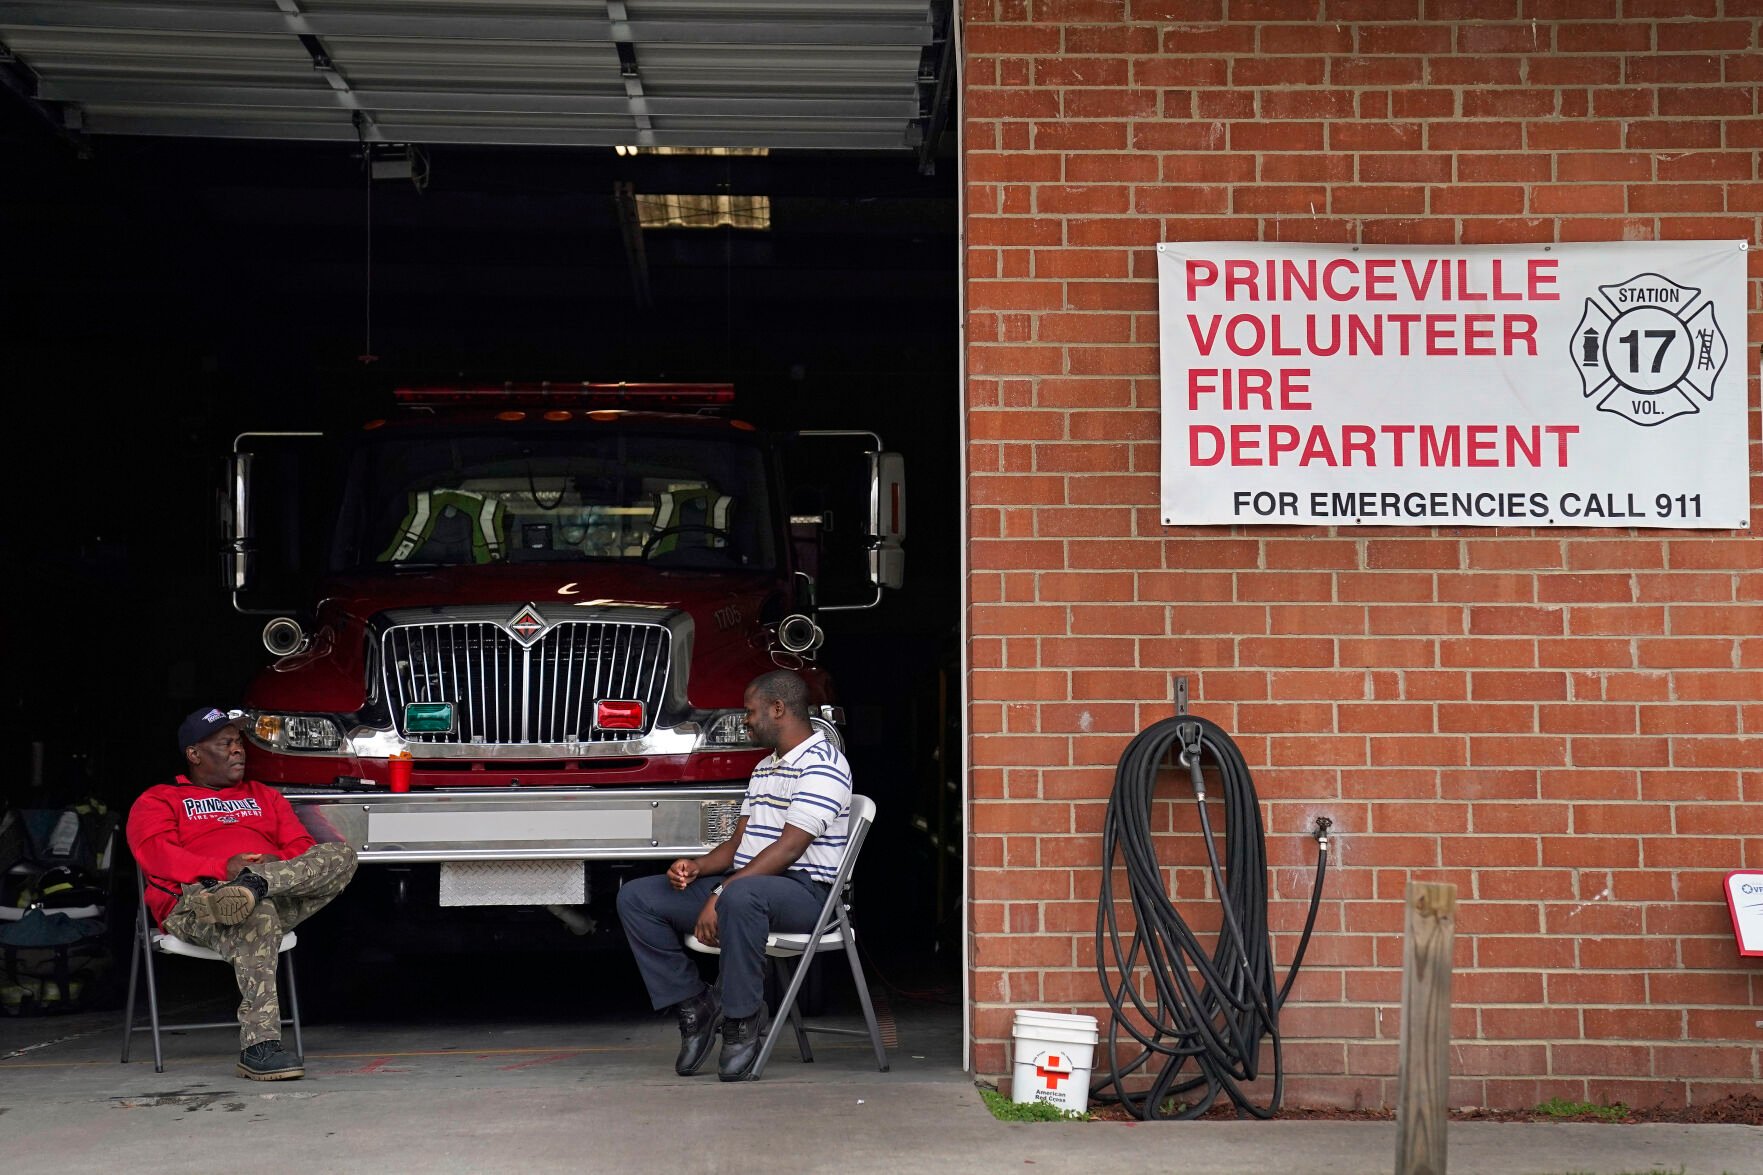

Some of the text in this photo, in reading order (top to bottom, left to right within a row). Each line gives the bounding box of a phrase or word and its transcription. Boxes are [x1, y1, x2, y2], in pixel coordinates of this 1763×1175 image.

[1186, 259, 1560, 302] PRINCEVILLE
[1618, 286, 1680, 304] STATION
[1187, 314, 1538, 356] VOLUNTEER
[1619, 329, 1677, 374] 17
[1188, 368, 1312, 411] FIRE
[1632, 400, 1665, 415] VOL.
[1188, 424, 1580, 468] DEPARTMENT
[1233, 491, 1702, 518] FOR EMERGENCIES CALL 911
[713, 604, 742, 629] 1705
[183, 798, 261, 817] PRINCEVILLE
[1036, 1089, 1066, 1097] American
